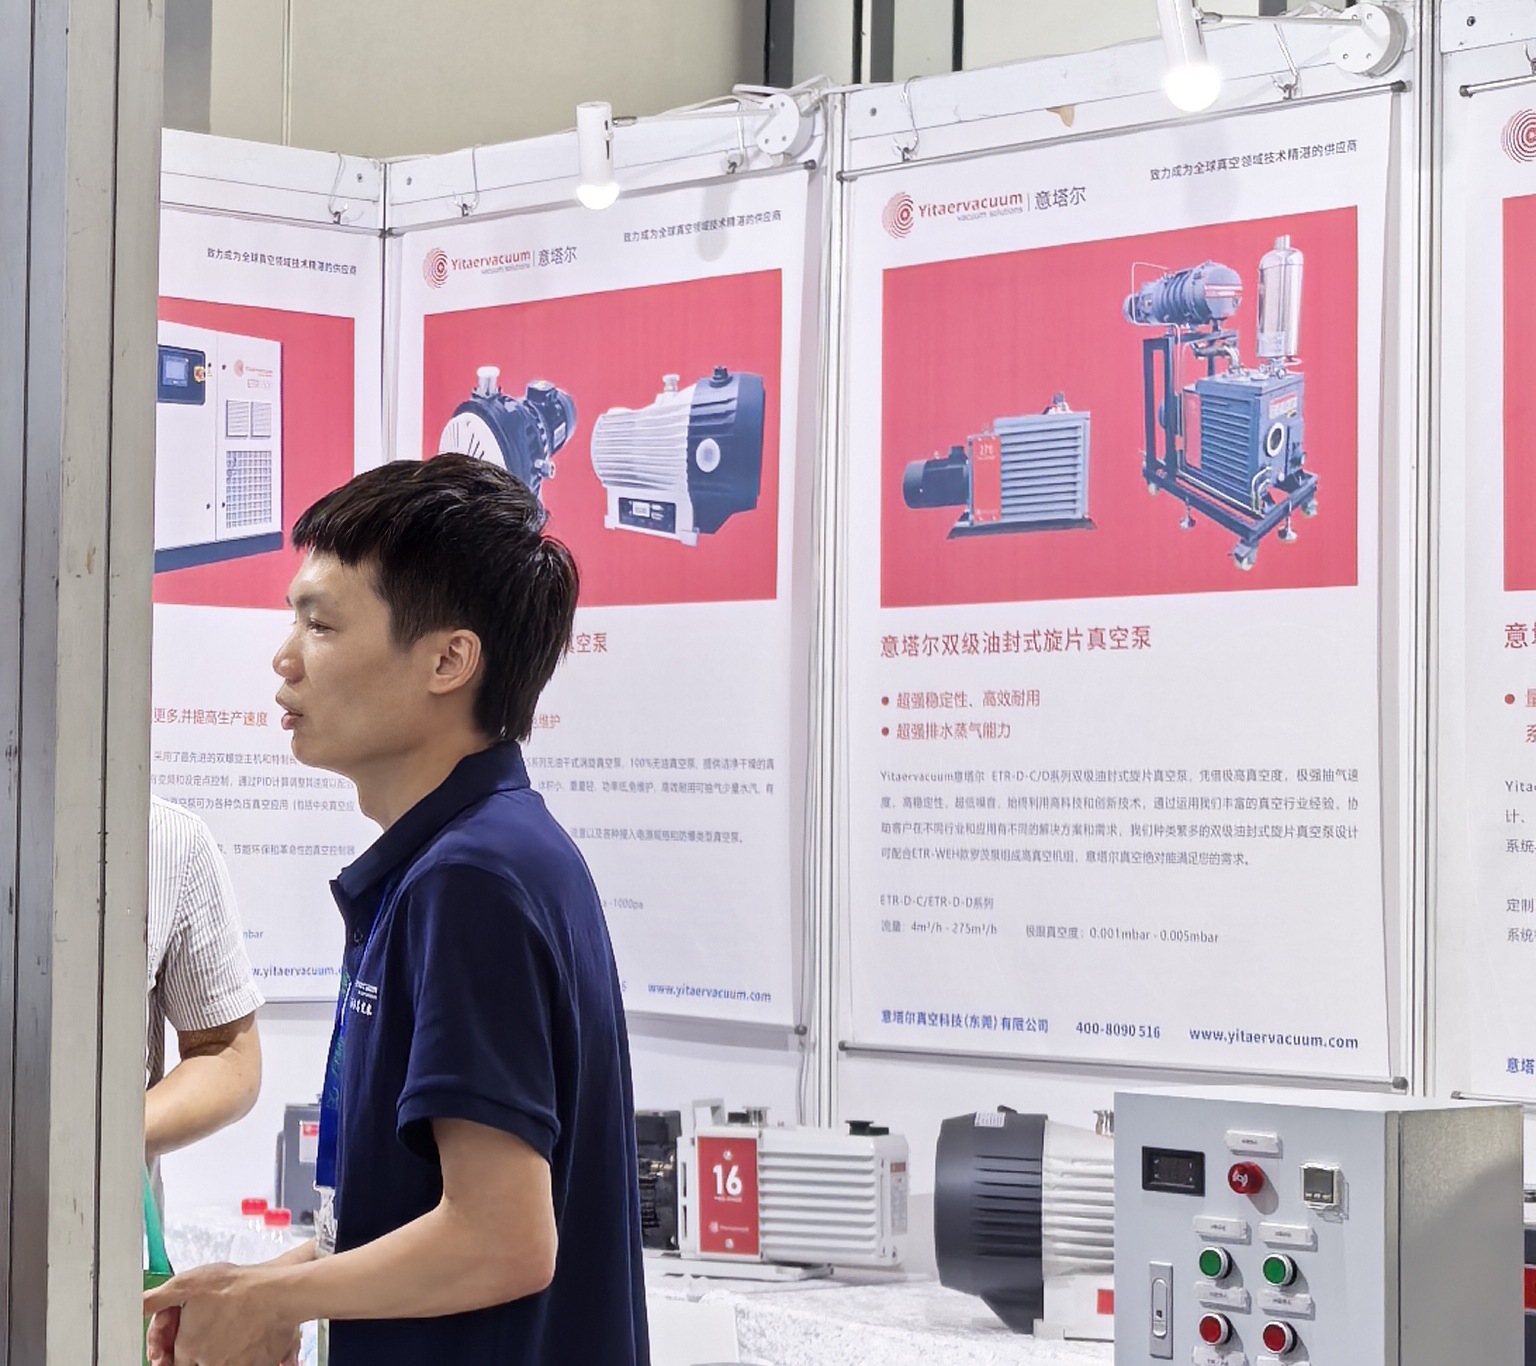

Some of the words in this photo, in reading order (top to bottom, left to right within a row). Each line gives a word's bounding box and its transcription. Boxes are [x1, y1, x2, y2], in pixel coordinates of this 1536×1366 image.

[918, 192, 1023, 219] Yitaervacuum
[1034, 186, 1087, 211] 意塔尔
[450, 249, 531, 271] Yitaervacuum
[538, 245, 577, 267] 意塔尔
[880, 624, 1152, 659] 意塔尔双级油封式旋片真空泵
[1505, 621, 1536, 649] 意
[1506, 838, 1536, 853] 系统
[1507, 927, 1536, 943] 系统
[1189, 1026, 1360, 1050] www.yitaervacuum.com
[712, 1163, 743, 1196] 16
